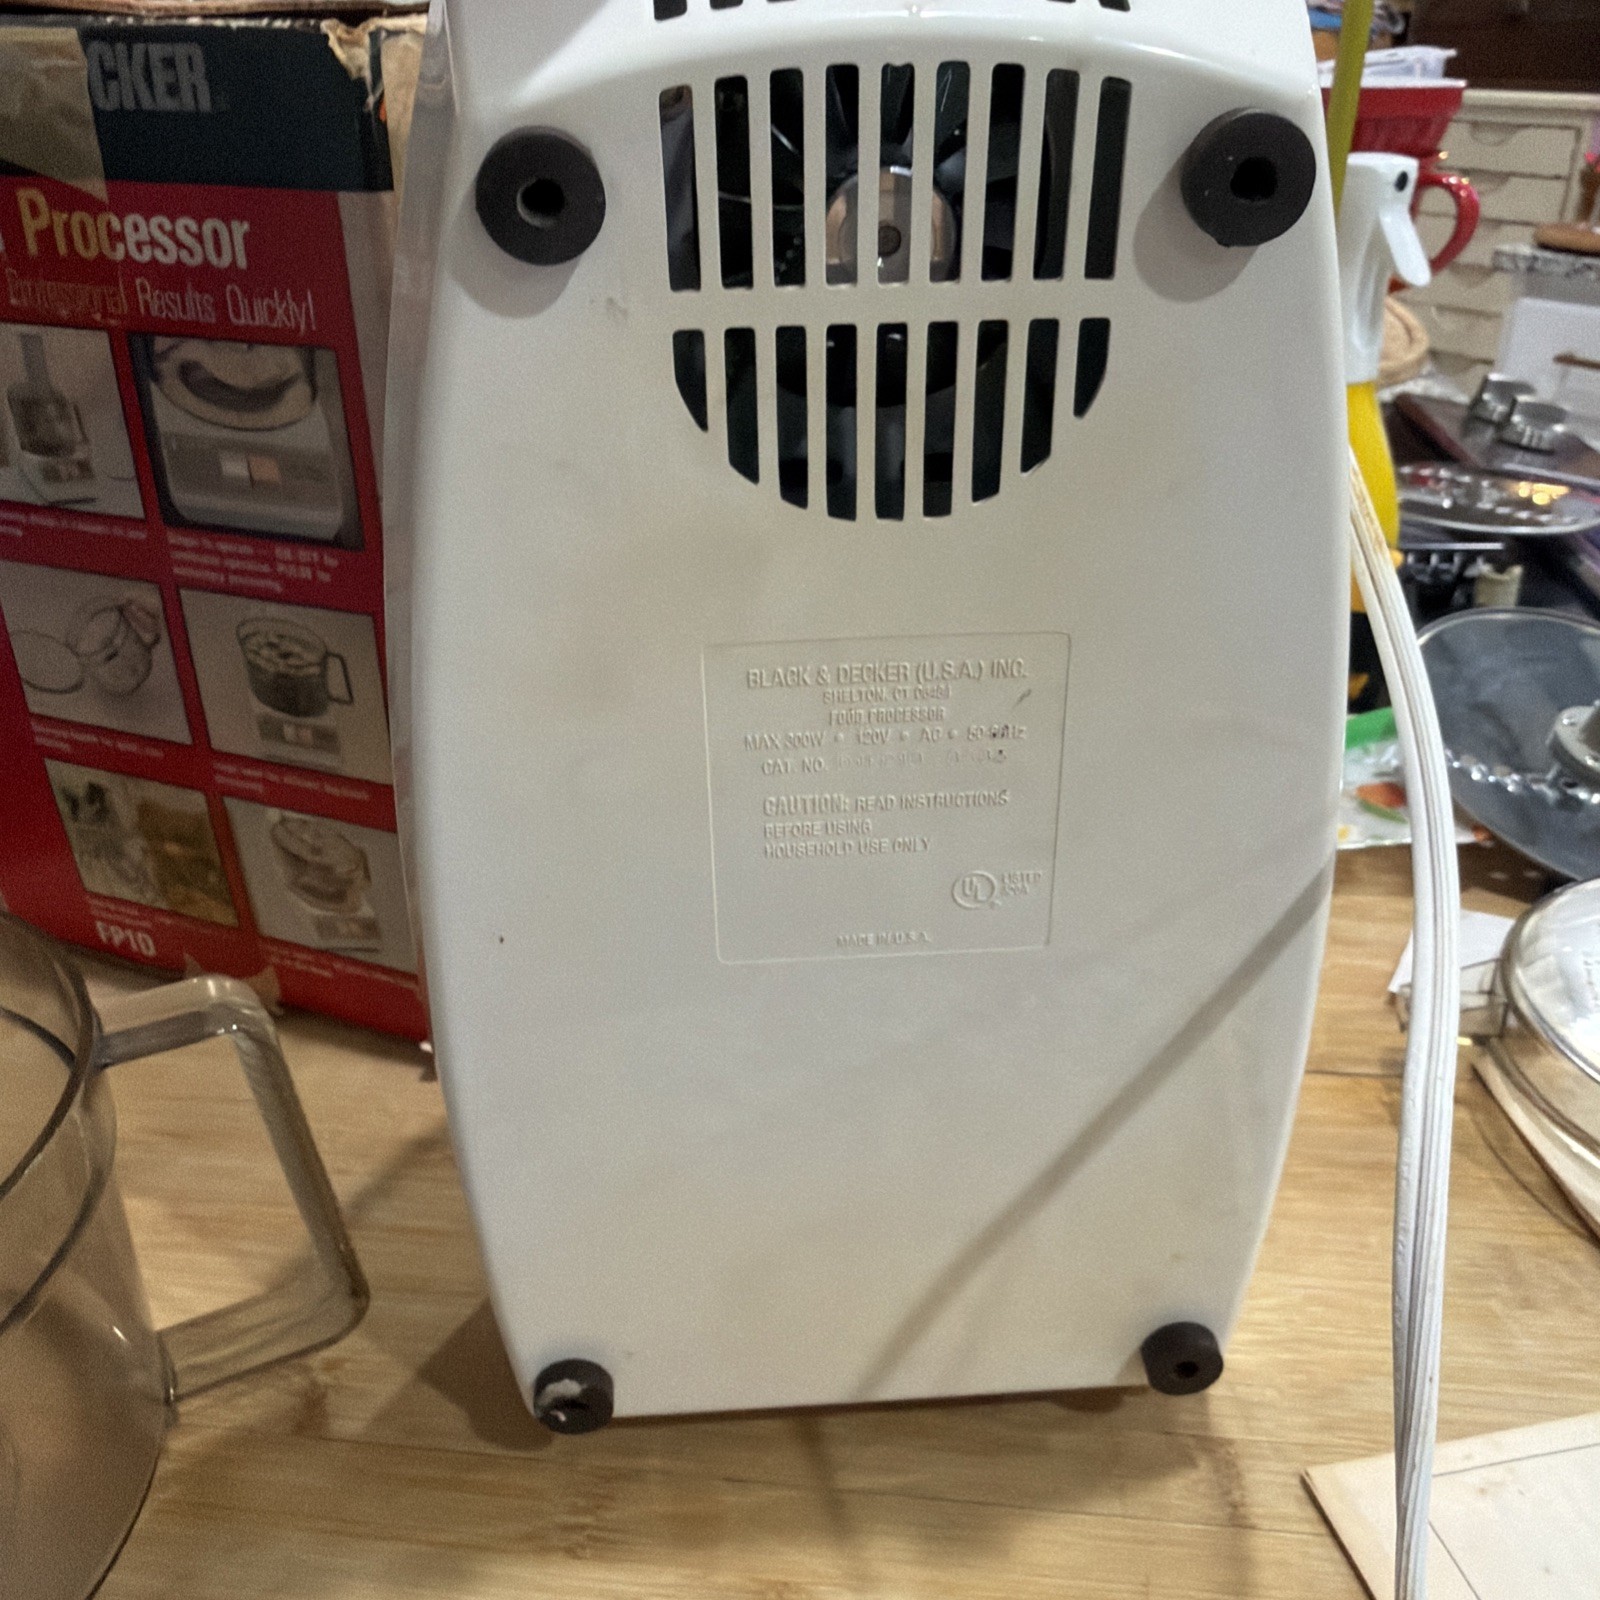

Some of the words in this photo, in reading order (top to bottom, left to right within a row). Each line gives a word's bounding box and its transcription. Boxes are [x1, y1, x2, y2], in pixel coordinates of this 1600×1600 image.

[86, 40, 213, 114] CKER
[16, 187, 250, 270] Processor
[135, 276, 217, 325] Results
[225, 283, 317, 336] Quickly!
[747, 667, 812, 689] BLACK
[816, 665, 830, 686] &
[837, 661, 910, 684] DECKER
[991, 658, 1029, 680] INC.
[868, 706, 947, 724] PROCESSOR
[744, 733, 780, 751] MAX
[857, 728, 892, 745] 120V
[921, 726, 942, 743] AC
[763, 792, 850, 816] CAUTION:
[854, 793, 896, 812] READ
[900, 789, 1009, 810] INSTRUCTIONS
[763, 821, 820, 839] BEFORE
[825, 817, 873, 836] USING
[764, 839, 854, 860] HOUSEHOLD
[858, 837, 889, 855] USE
[892, 836, 930, 853] ONLY
[96, 920, 157, 958] FP10
